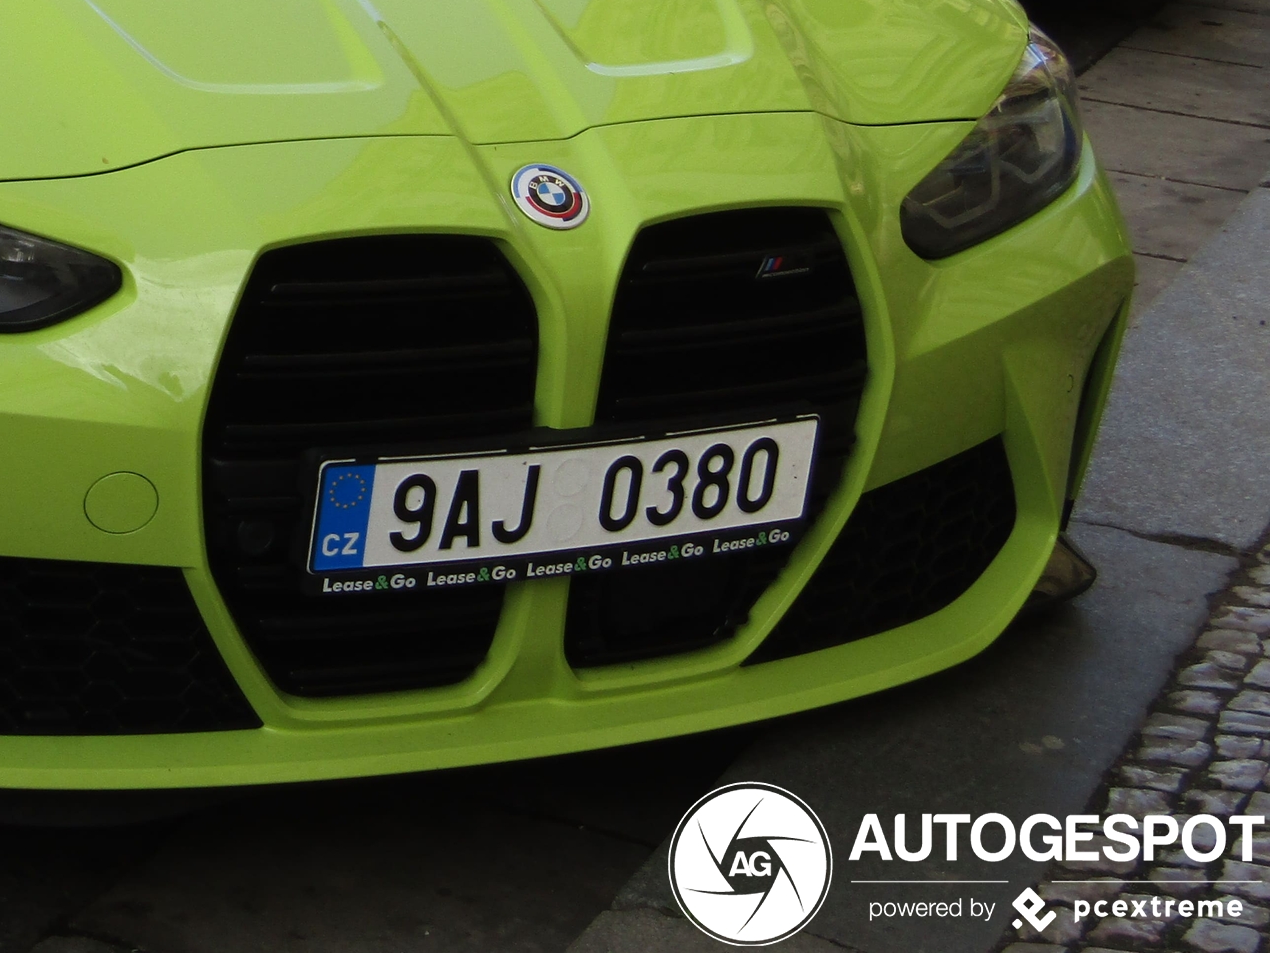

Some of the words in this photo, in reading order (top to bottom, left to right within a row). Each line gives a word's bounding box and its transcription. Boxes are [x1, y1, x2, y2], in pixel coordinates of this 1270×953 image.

[528, 175, 565, 190] BMW
[322, 532, 360, 556] CZ
[389, 464, 541, 552] 9AJ
[598, 437, 779, 532] 0380
[322, 573, 416, 593] Lease&Go
[426, 565, 517, 587] Lease&Go
[526, 554, 612, 578] Lease&Go
[621, 543, 704, 566] Lease&Go
[712, 528, 790, 554] Lease&Go
